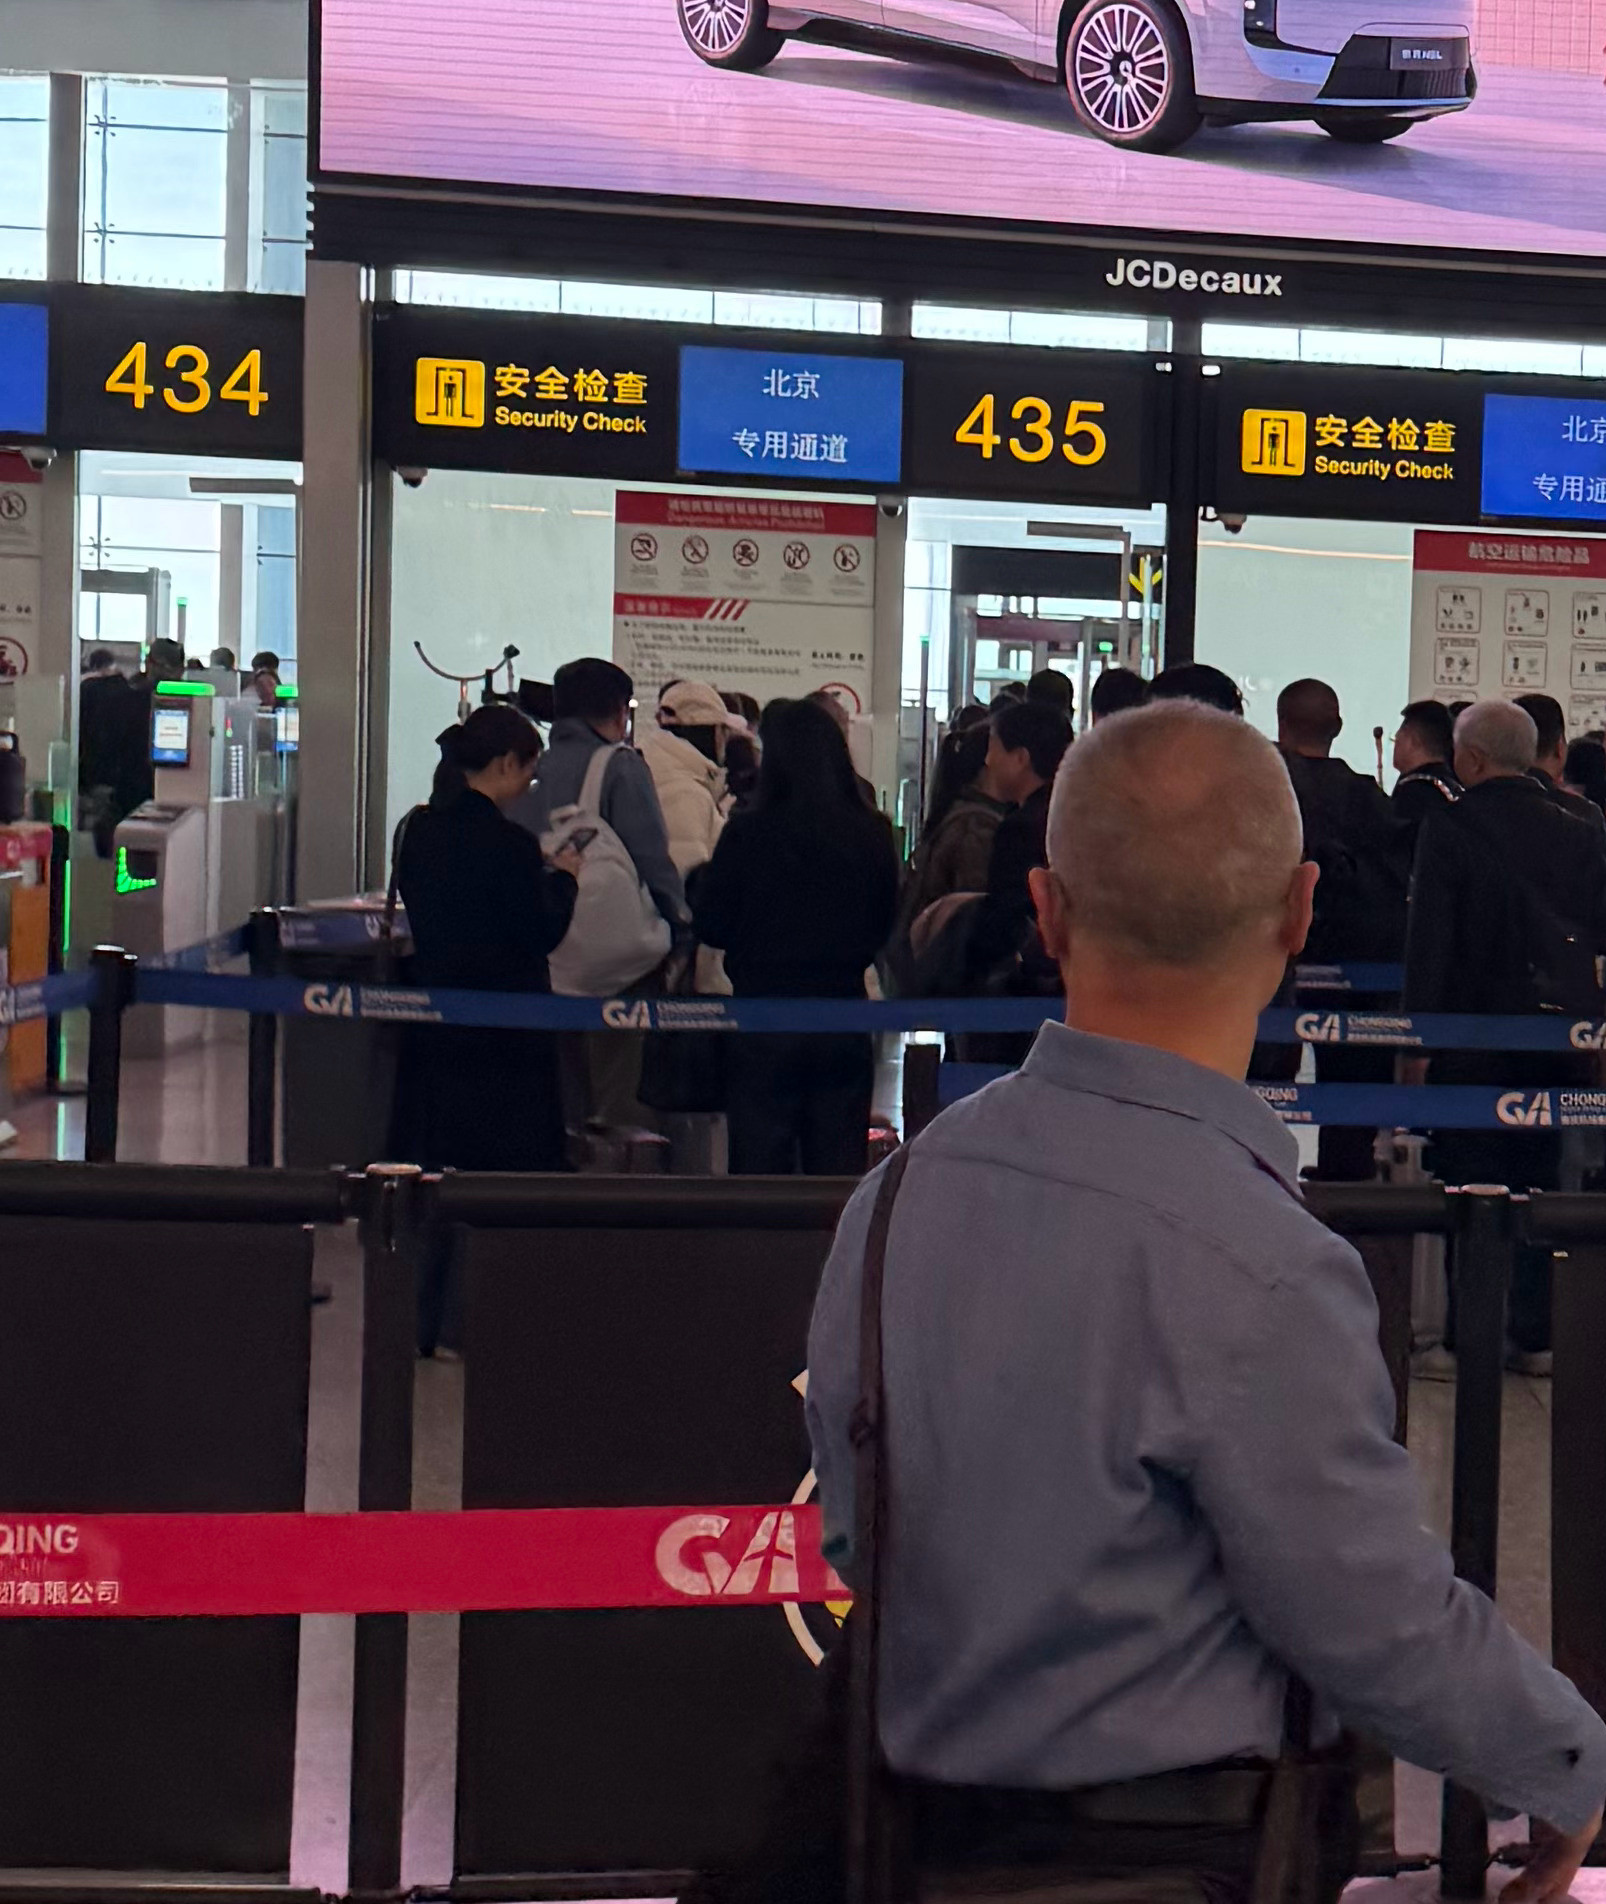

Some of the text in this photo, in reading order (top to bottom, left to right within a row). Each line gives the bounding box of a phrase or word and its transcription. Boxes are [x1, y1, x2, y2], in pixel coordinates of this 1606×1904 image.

[1105, 258, 1283, 296] JCDecaux
[104, 342, 268, 416] 434
[494, 363, 648, 406] 安全检查
[763, 369, 820, 399] 北京
[495, 406, 647, 434] Security Check
[955, 394, 1106, 466] 435
[1314, 414, 1456, 454] 安全检查
[732, 430, 848, 463] 专用通道
[1314, 455, 1454, 481] Security Check
